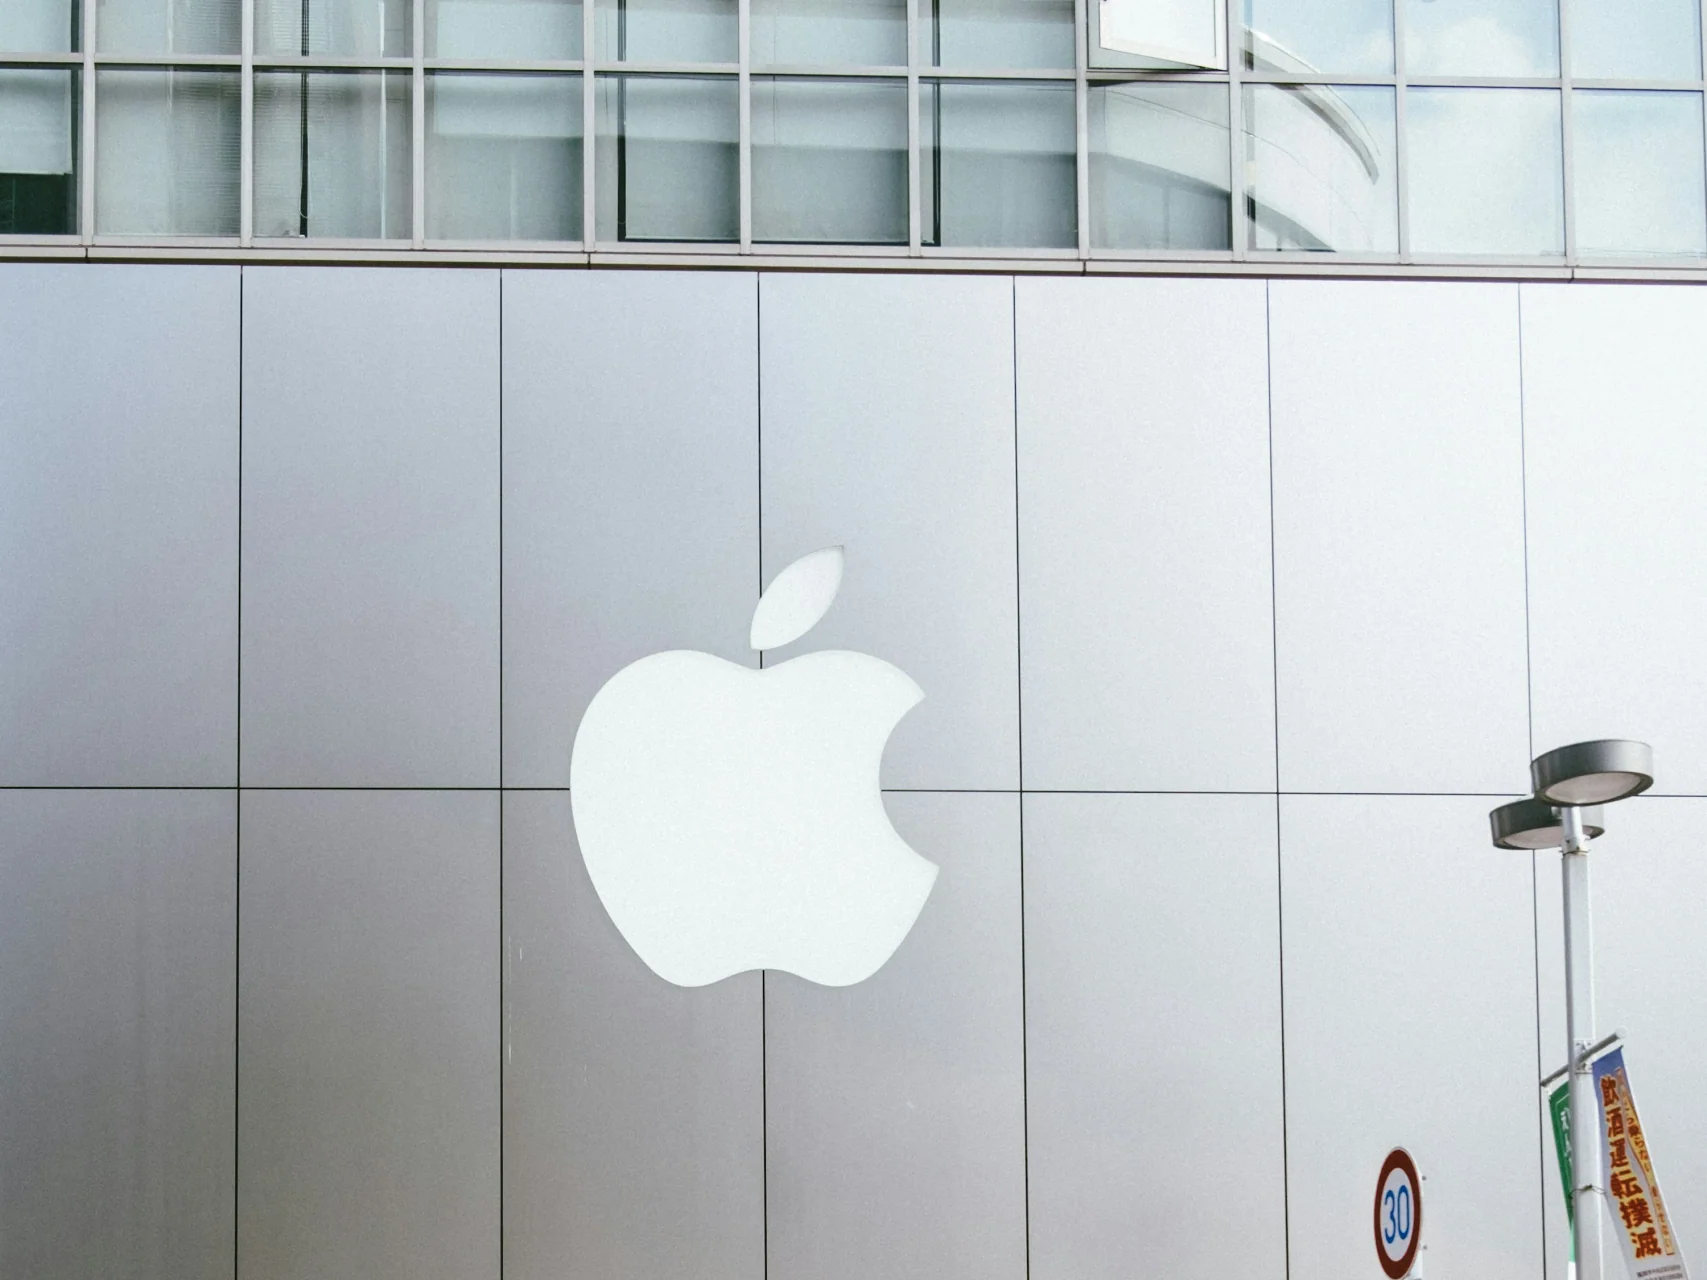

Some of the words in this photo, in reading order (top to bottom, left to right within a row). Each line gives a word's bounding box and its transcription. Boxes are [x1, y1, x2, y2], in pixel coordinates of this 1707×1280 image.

[1384, 1184, 1410, 1244] 30
[1601, 1076, 1662, 1259] 飲酒運転撲滅
